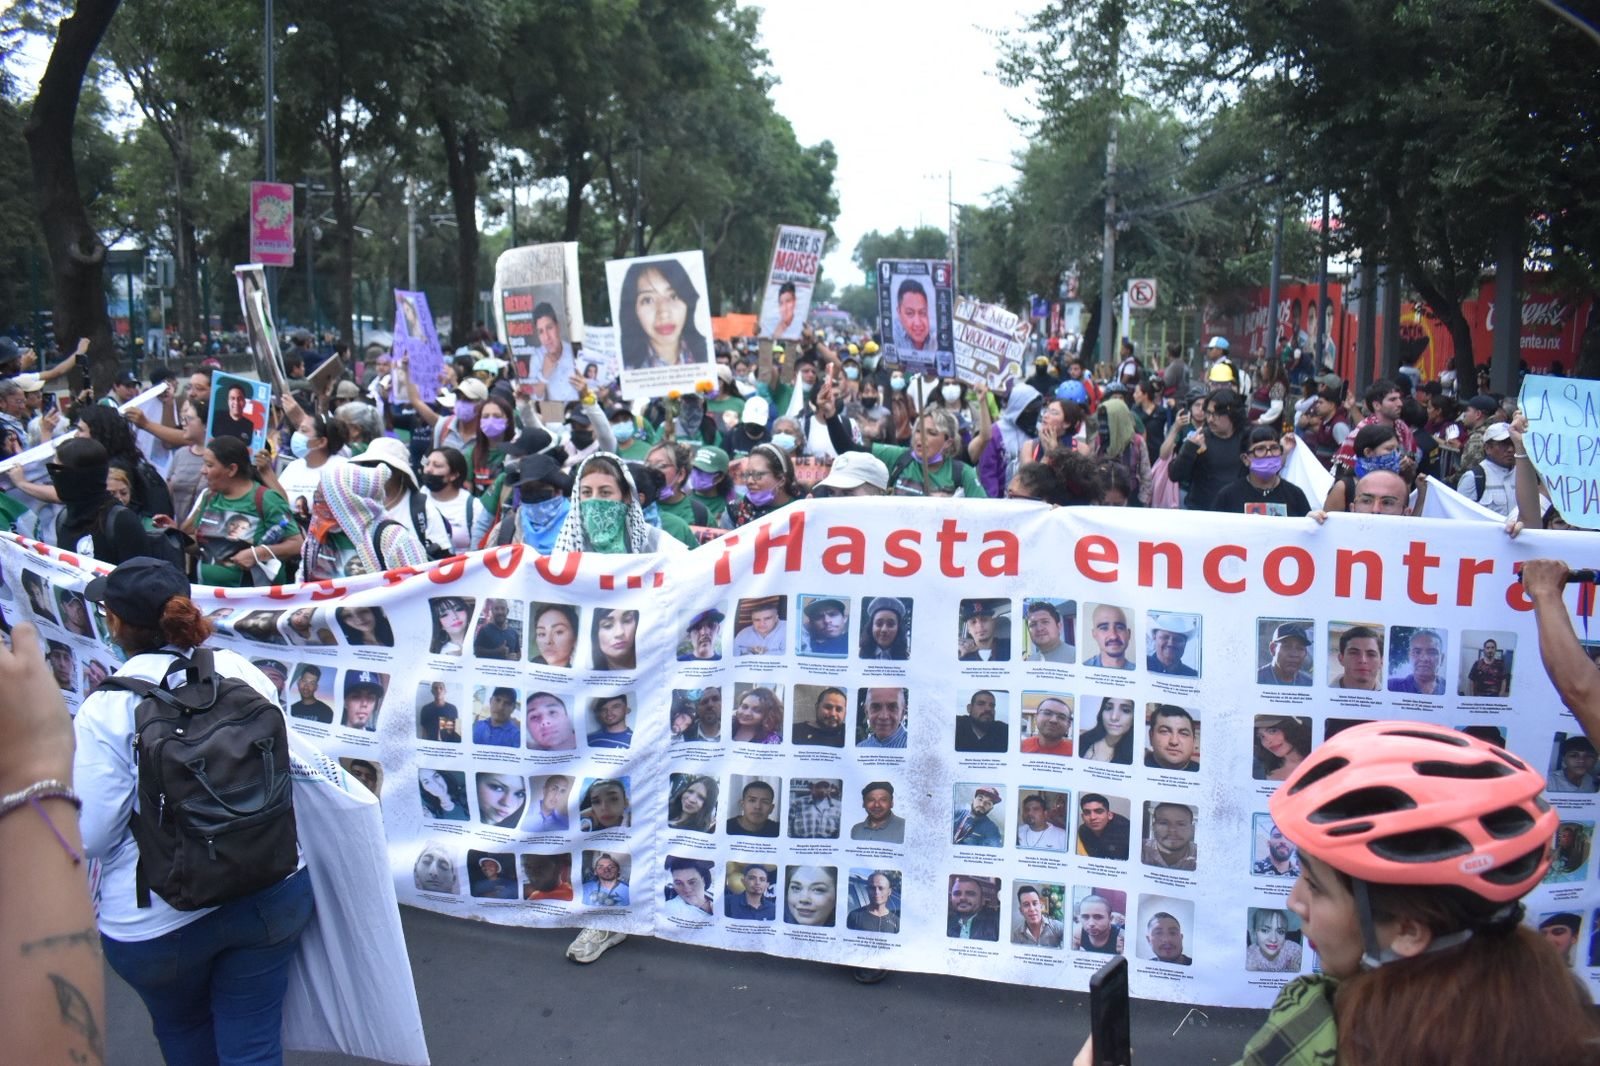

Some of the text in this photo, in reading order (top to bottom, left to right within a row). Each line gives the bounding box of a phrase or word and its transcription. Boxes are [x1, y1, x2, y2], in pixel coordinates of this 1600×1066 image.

[780, 232, 821, 254] WHERE IS
[775, 250, 818, 275] MOISES
[1520, 334, 1562, 349] ente.mx
[1521, 383, 1554, 423] LA
[714, 511, 1020, 586] ¡Hasta
[1075, 532, 1600, 618] encontr
